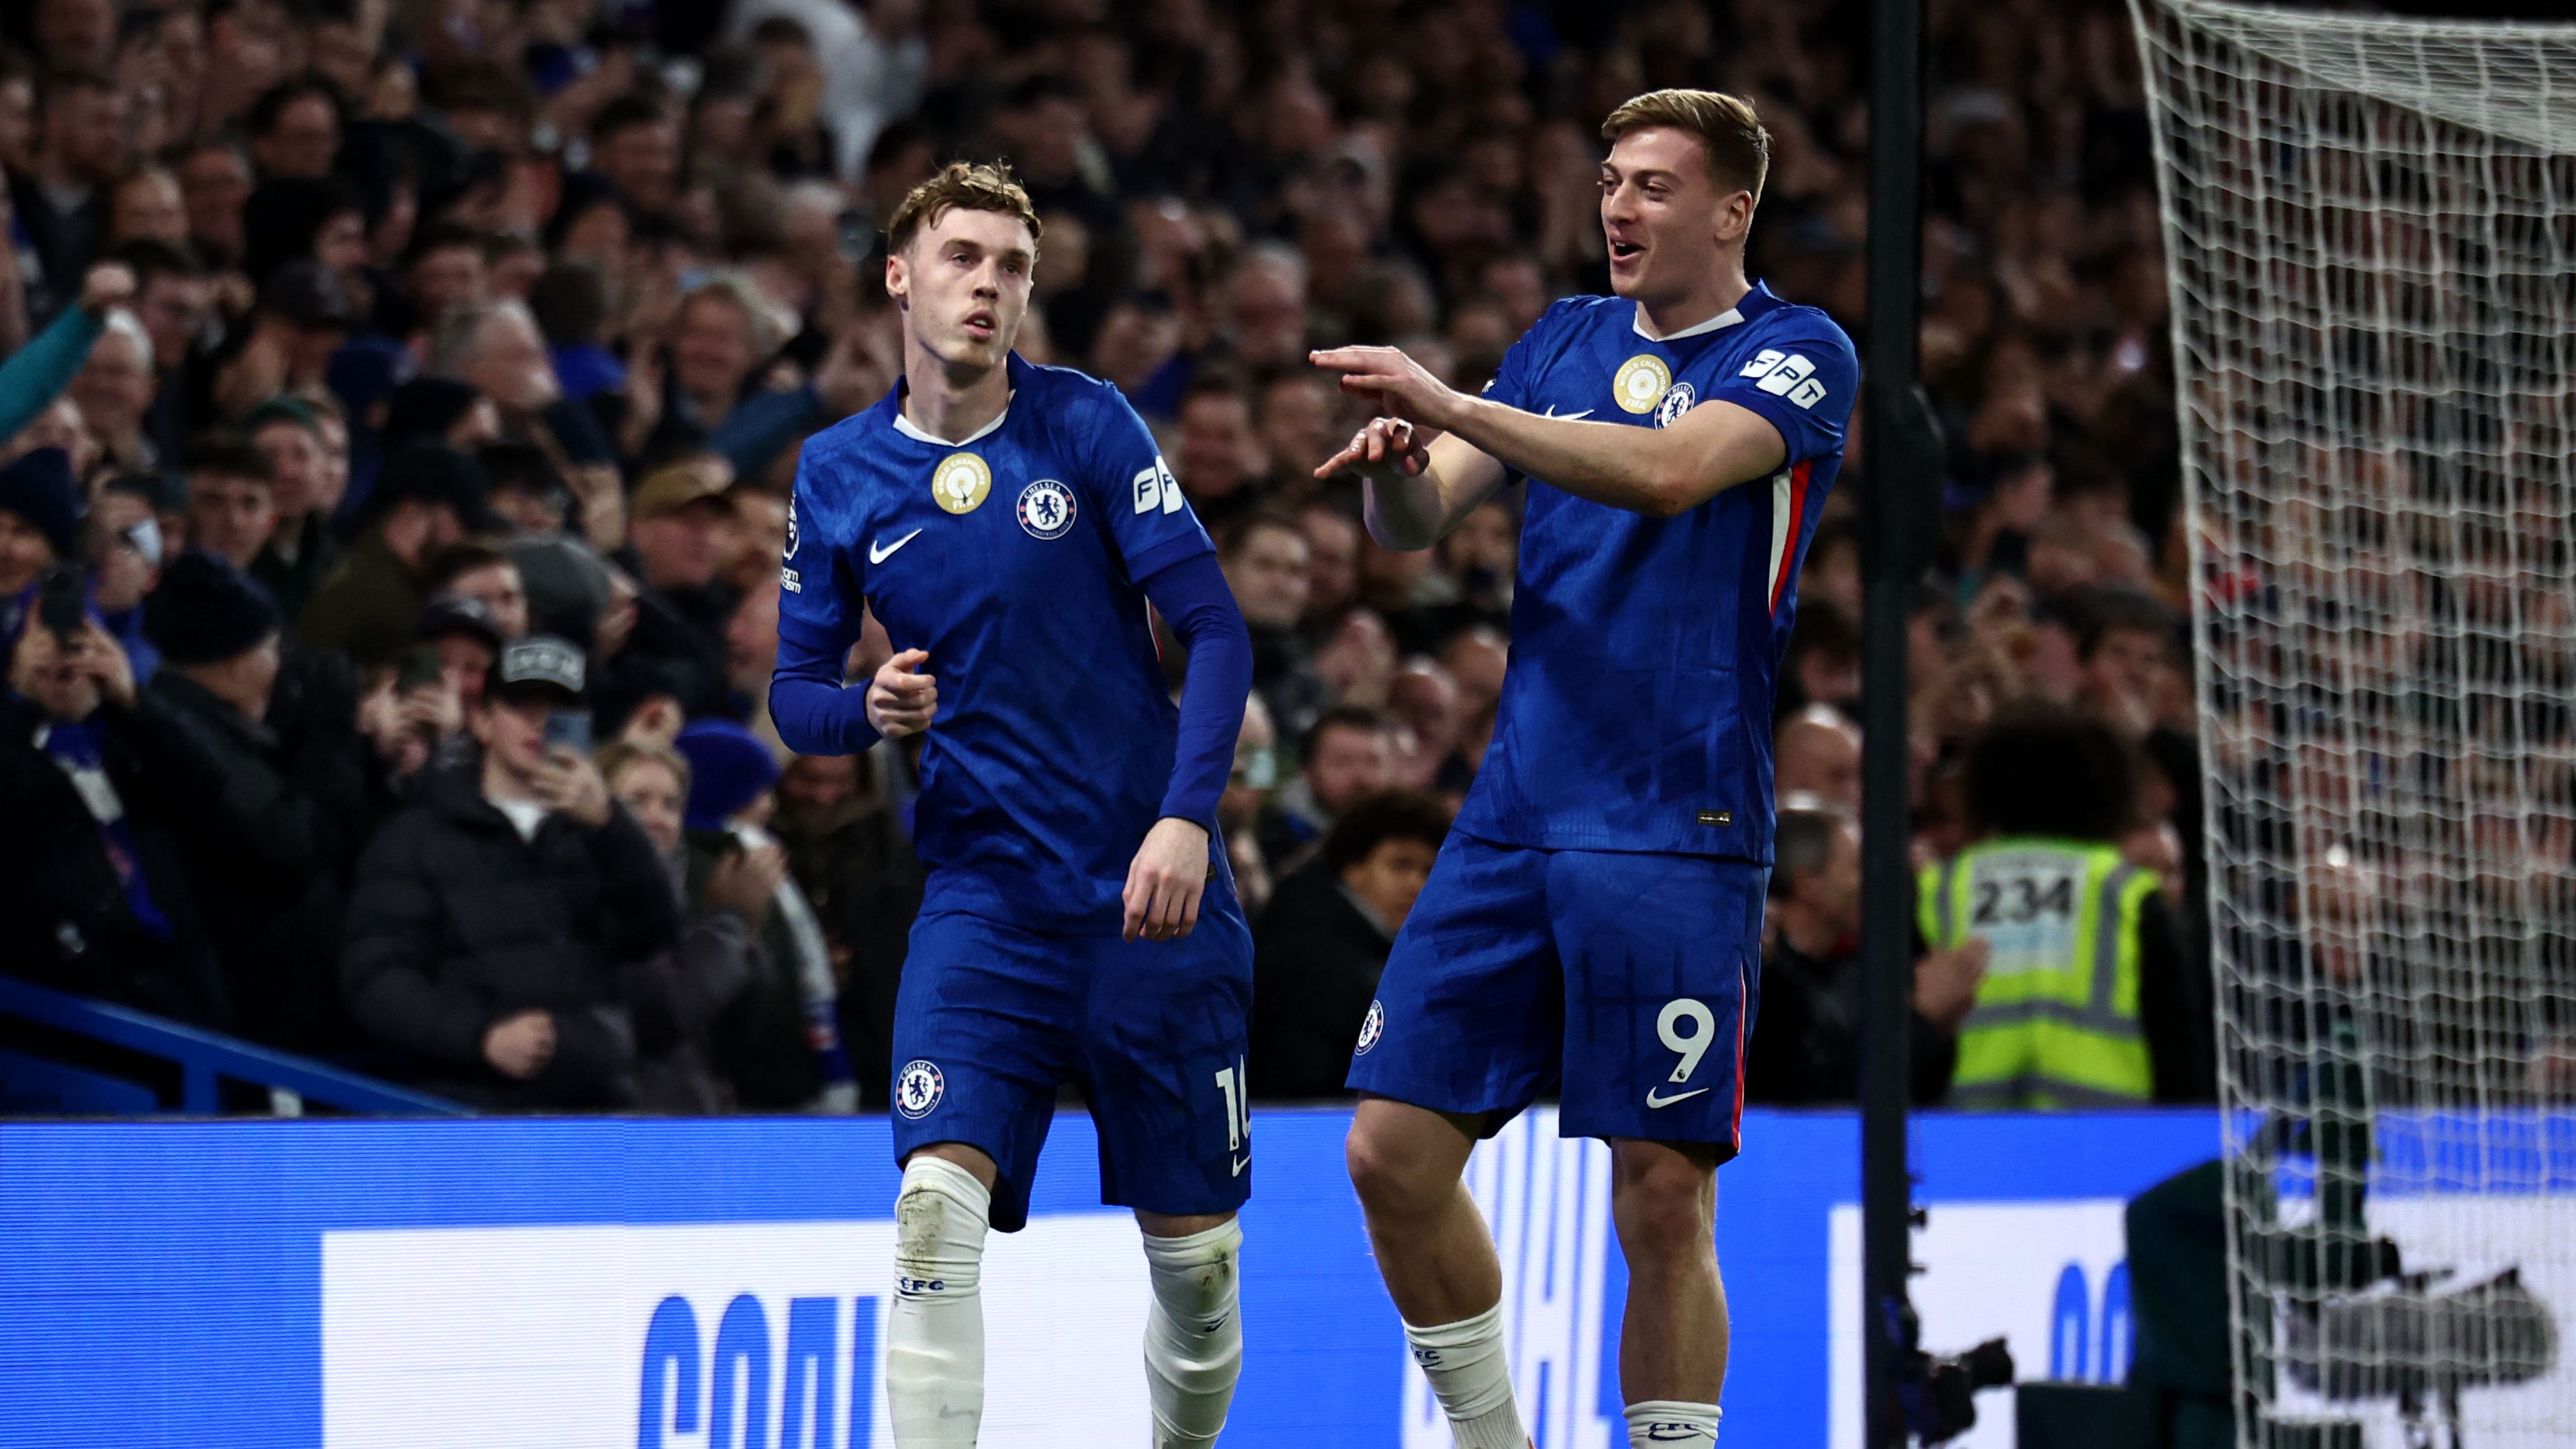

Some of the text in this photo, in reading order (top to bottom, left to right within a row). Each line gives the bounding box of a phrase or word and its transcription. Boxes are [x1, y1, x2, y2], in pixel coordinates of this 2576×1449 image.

[1619, 360, 1666, 396] WORLD CHAMPIONS
[1667, 385, 1691, 397] CHELSEA
[1625, 398, 1647, 410] FIFA
[937, 458, 986, 496] WORLD CHAMPIONS
[1023, 482, 1061, 499] CHELSEA
[1974, 877, 2071, 925] 234
[1657, 998, 1715, 1083] 9
[901, 1063, 932, 1080] CHELSEA
